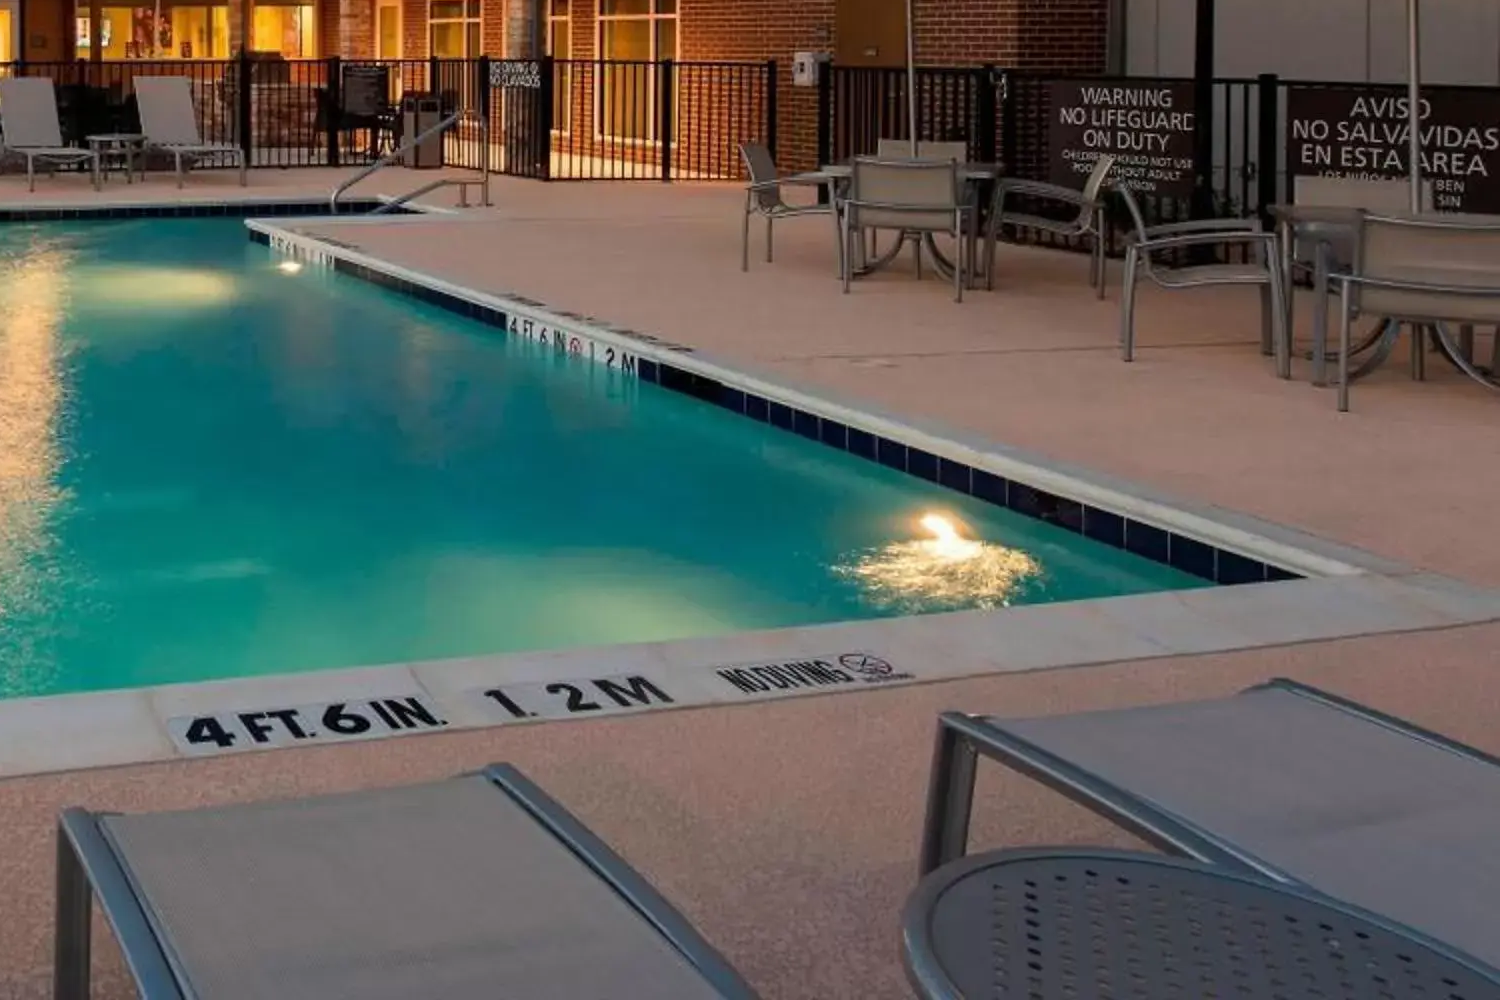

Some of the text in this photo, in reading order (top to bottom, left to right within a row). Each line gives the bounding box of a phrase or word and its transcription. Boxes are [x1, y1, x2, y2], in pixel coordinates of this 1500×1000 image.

[1081, 87, 1173, 107] WARNING
[1350, 96, 1431, 120] AVISO
[1060, 107, 1086, 125] NO
[1083, 129, 1171, 152] ON DUTY
[1293, 119, 1499, 150] NO SALVAVIDAS
[1301, 143, 1331, 165] EN
[1341, 147, 1403, 170] ESTA
[1073, 162, 1093, 173] POO
[1110, 165, 1145, 178] ITHOUT
[509, 317, 518, 335] 4
[523, 319, 534, 339] FT
[539, 328, 549, 345] 6
[553, 329, 566, 351] IN
[716, 668, 771, 693] NO
[750, 660, 854, 689] DIVING
[185, 716, 236, 748] 4
[368, 697, 449, 730] IN.
